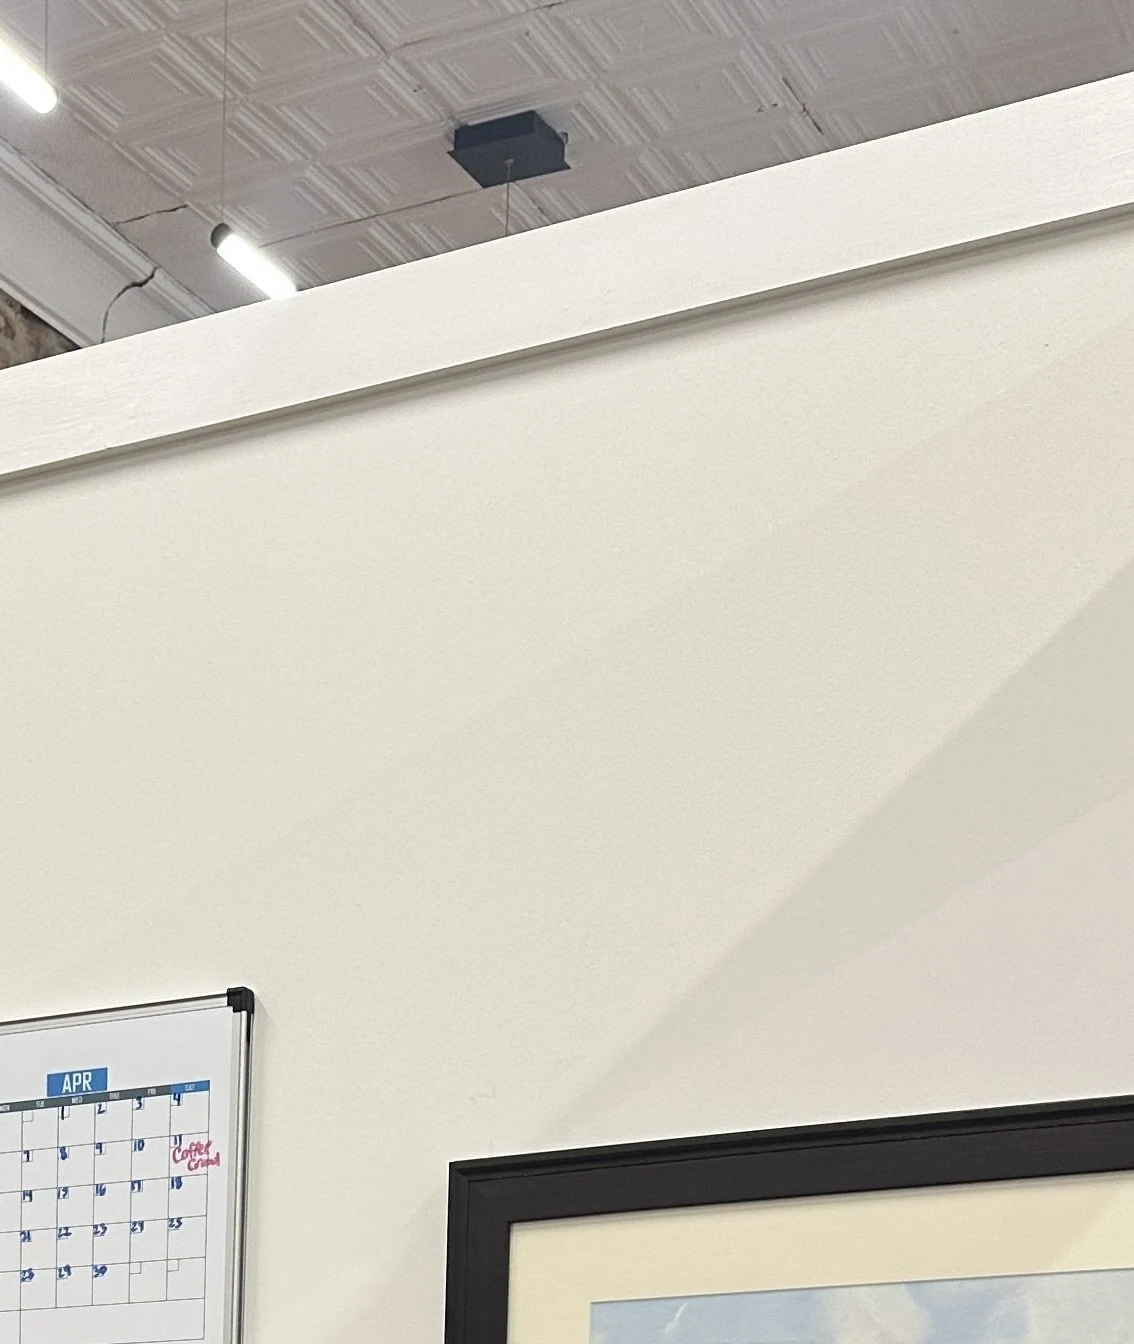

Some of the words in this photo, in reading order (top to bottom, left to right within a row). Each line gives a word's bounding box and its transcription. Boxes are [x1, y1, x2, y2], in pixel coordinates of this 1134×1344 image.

[62, 1072, 92, 1095] APR
[61, 1106, 65, 1120] 1
[98, 1104, 105, 1114] 2
[135, 1097, 142, 1110] 3
[173, 1093, 181, 1106] 4
[134, 1139, 145, 1151] 10
[174, 1135, 182, 1147] 11
[95, 1184, 106, 1196] 16
[171, 1176, 182, 1190] 18
[58, 1227, 72, 1238] 22
[93, 1223, 107, 1236] 23
[169, 1217, 183, 1229] 25
[93, 1265, 107, 1278] 30
